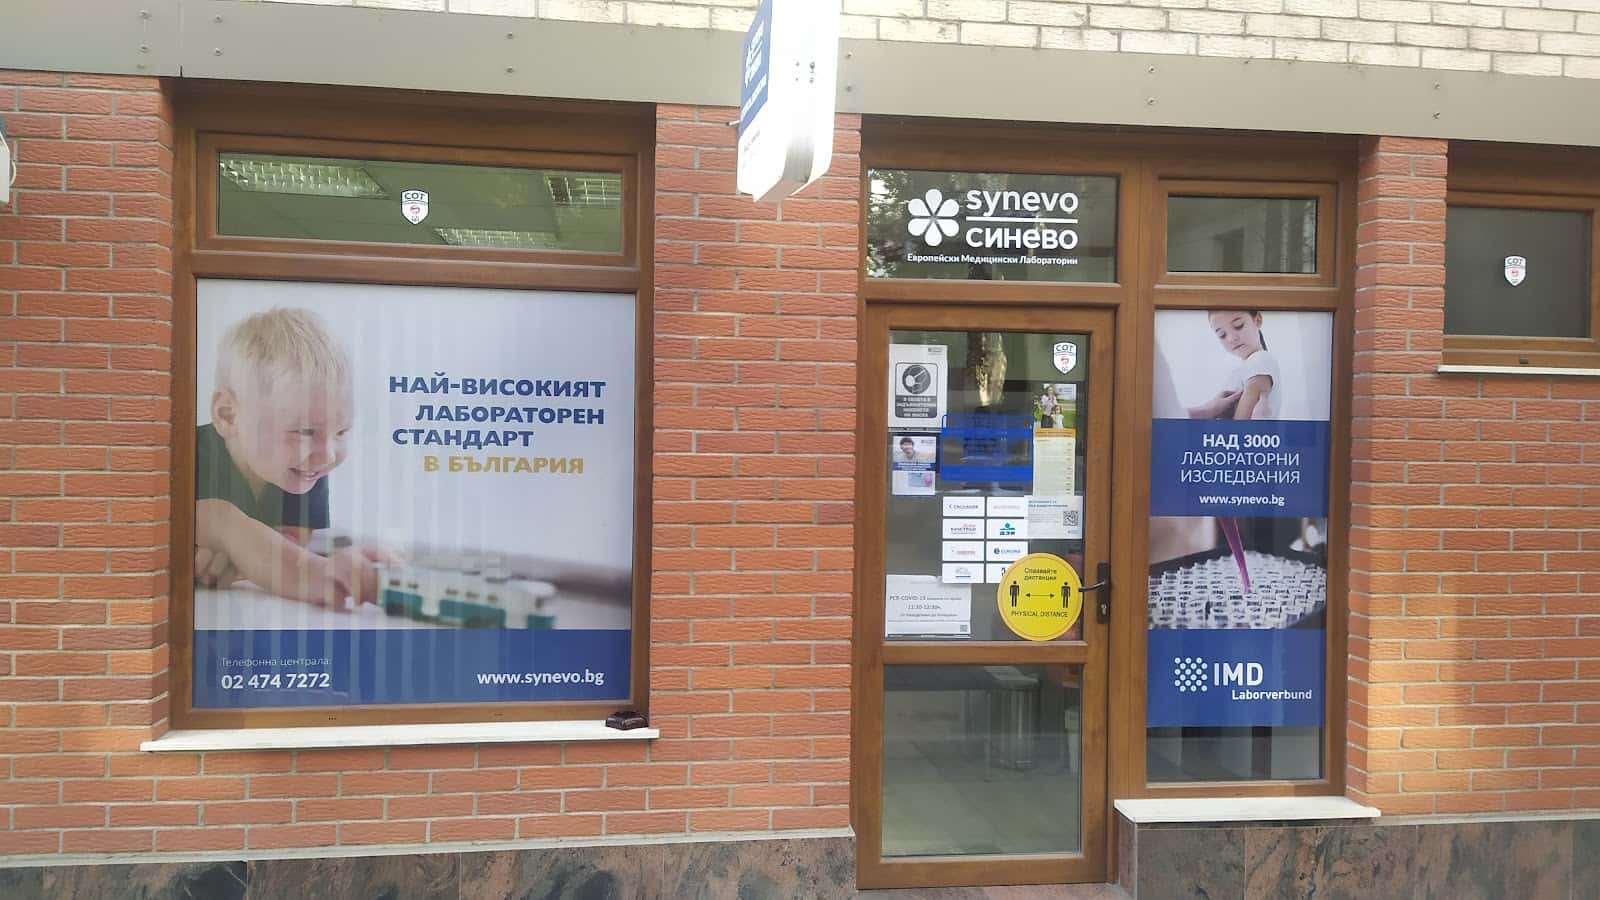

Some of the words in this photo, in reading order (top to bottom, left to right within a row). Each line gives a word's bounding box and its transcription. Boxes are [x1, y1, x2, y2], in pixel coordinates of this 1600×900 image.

[966, 189, 1079, 217] synevo
[907, 253, 960, 264] Европейски
[961, 254, 1018, 265] Медицински
[1019, 256, 1078, 266] Лаборатории
[389, 372, 606, 398] НАЙ-ВИСОКИЯТ
[415, 405, 605, 425] ЛАБОРАТОРЕН
[392, 428, 534, 450] СТАНДАРТ
[1203, 434, 1240, 450] НАД
[1243, 434, 1280, 448] 3000
[423, 456, 440, 472] В
[448, 456, 584, 474] БЪЛГАРИЯ
[1181, 451, 1300, 466] ЛАБОРАТОРНИ
[1180, 469, 1301, 486] ИЗСЛЕДВАНИЯ
[1199, 494, 1285, 506] www.synevo.bg
[222, 656, 277, 668] Телефонна
[221, 674, 244, 689] 02
[248, 673, 282, 689] 474
[286, 673, 330, 688] 7272
[476, 669, 605, 686] www.synevo.bg
[1213, 662, 1264, 686] IMD
[1231, 689, 1312, 700] Laborverbund
